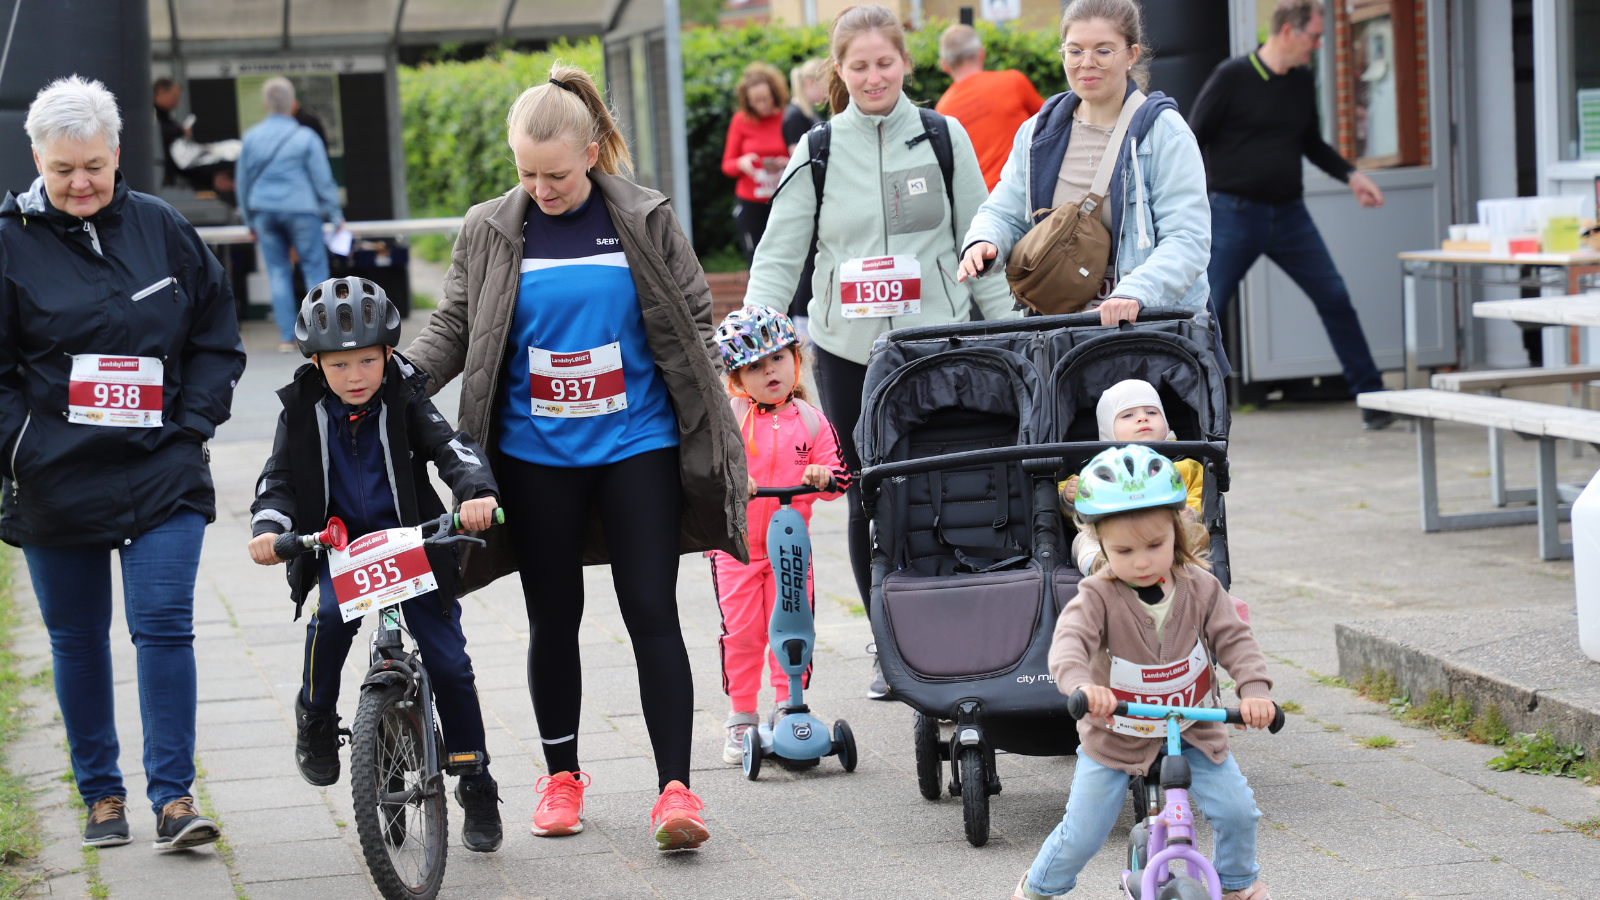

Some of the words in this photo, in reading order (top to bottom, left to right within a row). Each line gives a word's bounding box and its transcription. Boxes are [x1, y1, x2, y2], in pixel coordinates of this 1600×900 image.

[596, 237, 620, 245] SÆBY
[855, 281, 903, 302] 1309
[99, 361, 139, 369] LandsbyLØBET
[551, 354, 590, 364] LandsbyLØBET
[94, 383, 140, 408] 938
[550, 377, 596, 400] 937
[349, 534, 387, 553] LandsbyLØBET
[353, 558, 402, 594] 935
[791, 544, 804, 590] RIDE
[779, 545, 793, 613] SCOOT
[1016, 674, 1035, 685] city
[1142, 662, 1189, 679] LandsbyLØBET
